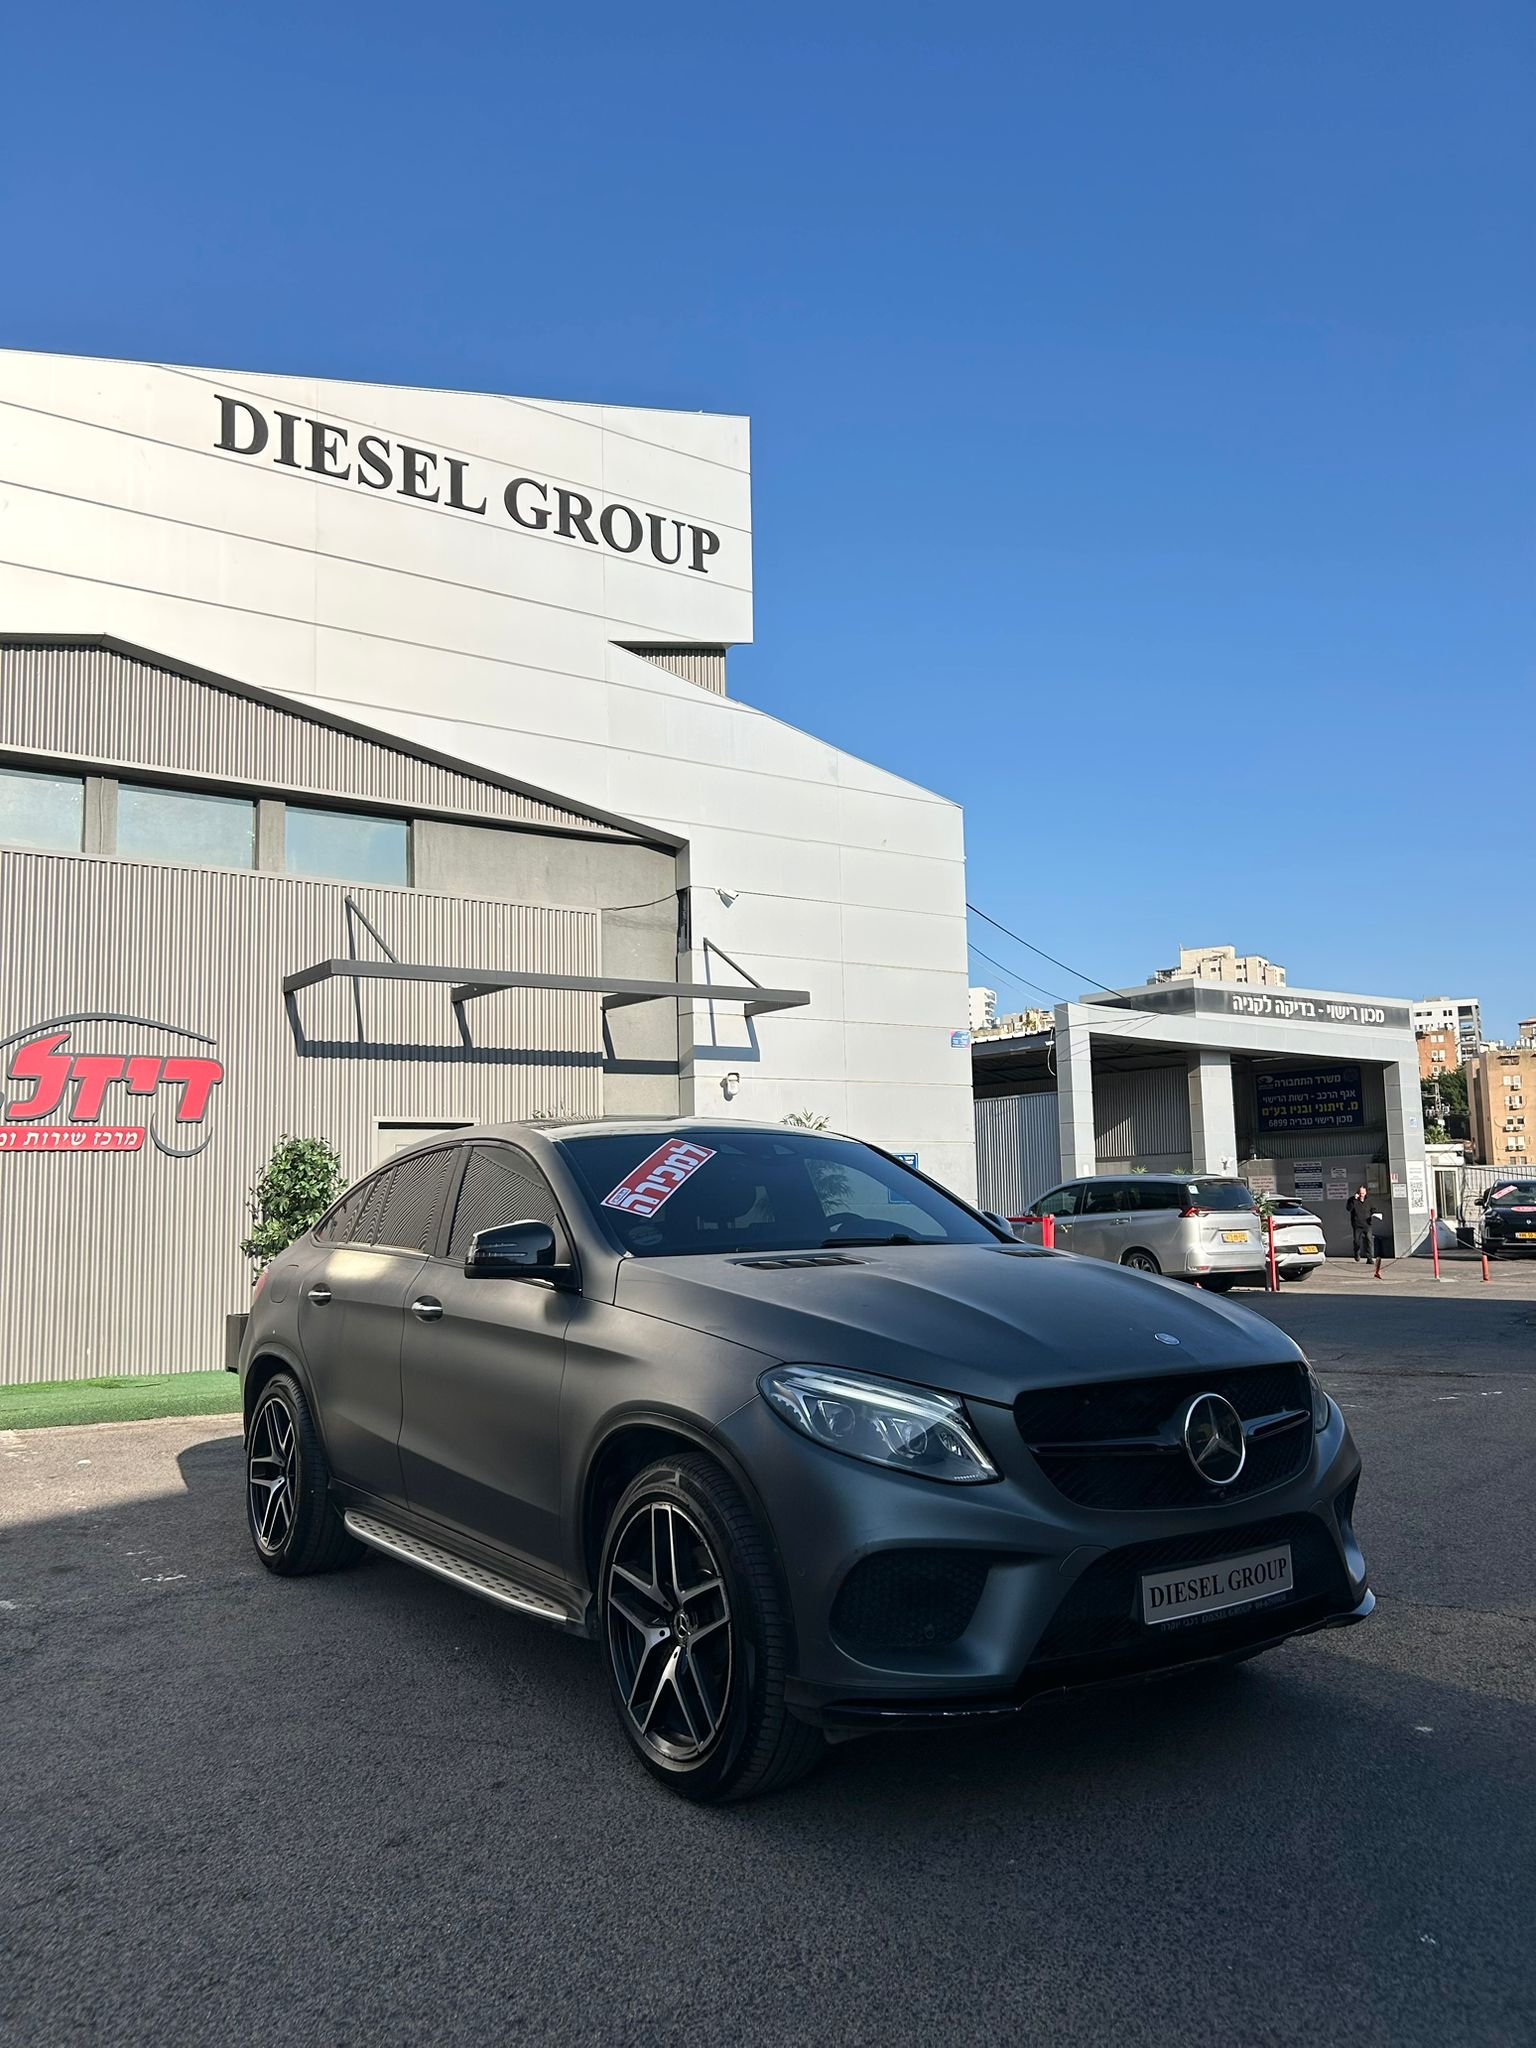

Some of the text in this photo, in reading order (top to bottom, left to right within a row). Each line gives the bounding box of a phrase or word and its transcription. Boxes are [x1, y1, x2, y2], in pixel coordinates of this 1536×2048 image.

[214, 394, 720, 573] DIESEL GROUP
[1232, 994, 1272, 1015] לקניה
[1275, 999, 1315, 1017] בדיקה
[1326, 1004, 1358, 1021] רישוי
[1360, 1007, 1385, 1024] מכון
[5, 1031, 224, 1122] דיזל
[1274, 1076, 1313, 1088] התחבורה
[1314, 1074, 1341, 1084] משרד
[1288, 1093, 1309, 1102] רשות
[1316, 1091, 1338, 1100] הרכב
[1340, 1089, 1356, 1100] אגף
[1290, 1104, 1312, 1114] ובניו
[1315, 1102, 1344, 1113] זיתוני
[1268, 1115, 1353, 1127] מכון רישוי טבריה 6899
[23, 1131, 87, 1146] שירות
[93, 1131, 138, 1146] מרכז
[620, 1143, 708, 1214] למכירה
[1149, 1574, 1225, 1608] DIESEL
[1228, 1557, 1287, 1591] GROUP
